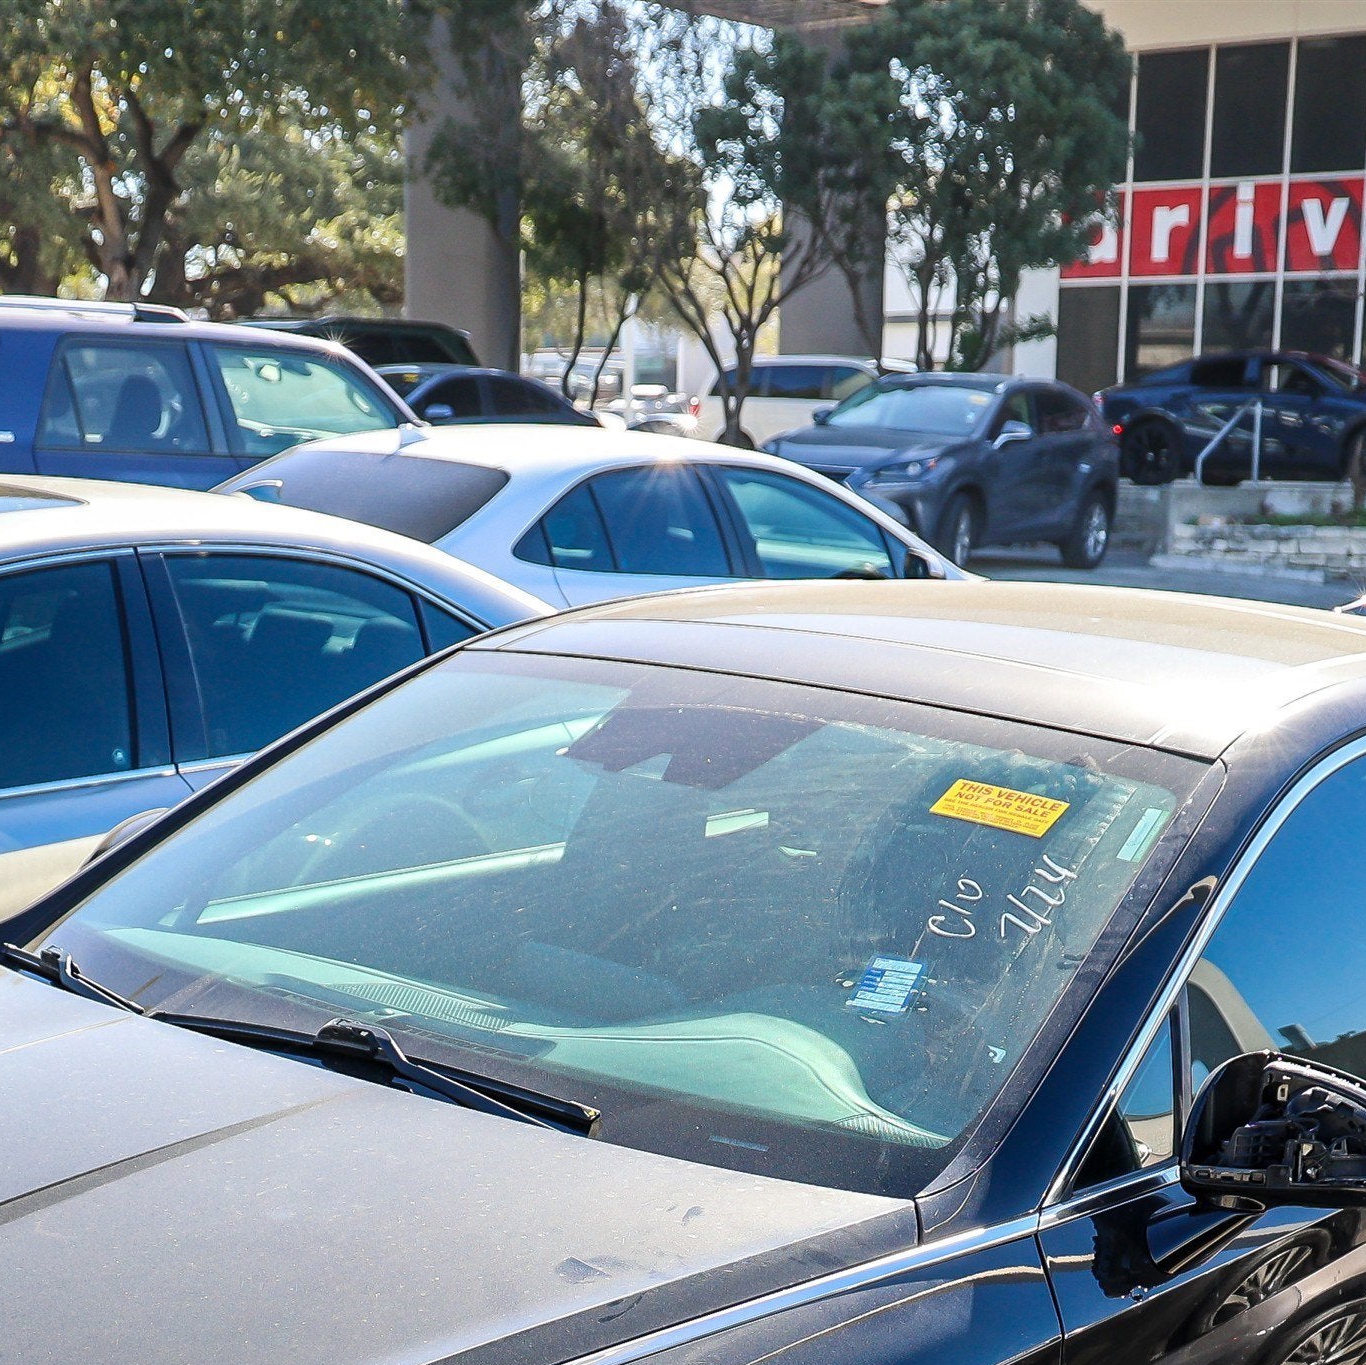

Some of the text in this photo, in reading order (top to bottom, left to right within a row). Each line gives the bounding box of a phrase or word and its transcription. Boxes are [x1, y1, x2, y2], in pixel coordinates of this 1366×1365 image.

[955, 792, 982, 802] NOT
[984, 797, 1013, 809] FOR
[1015, 804, 1051, 818] SALE
[960, 782, 1062, 812] THIS VEHICLE
